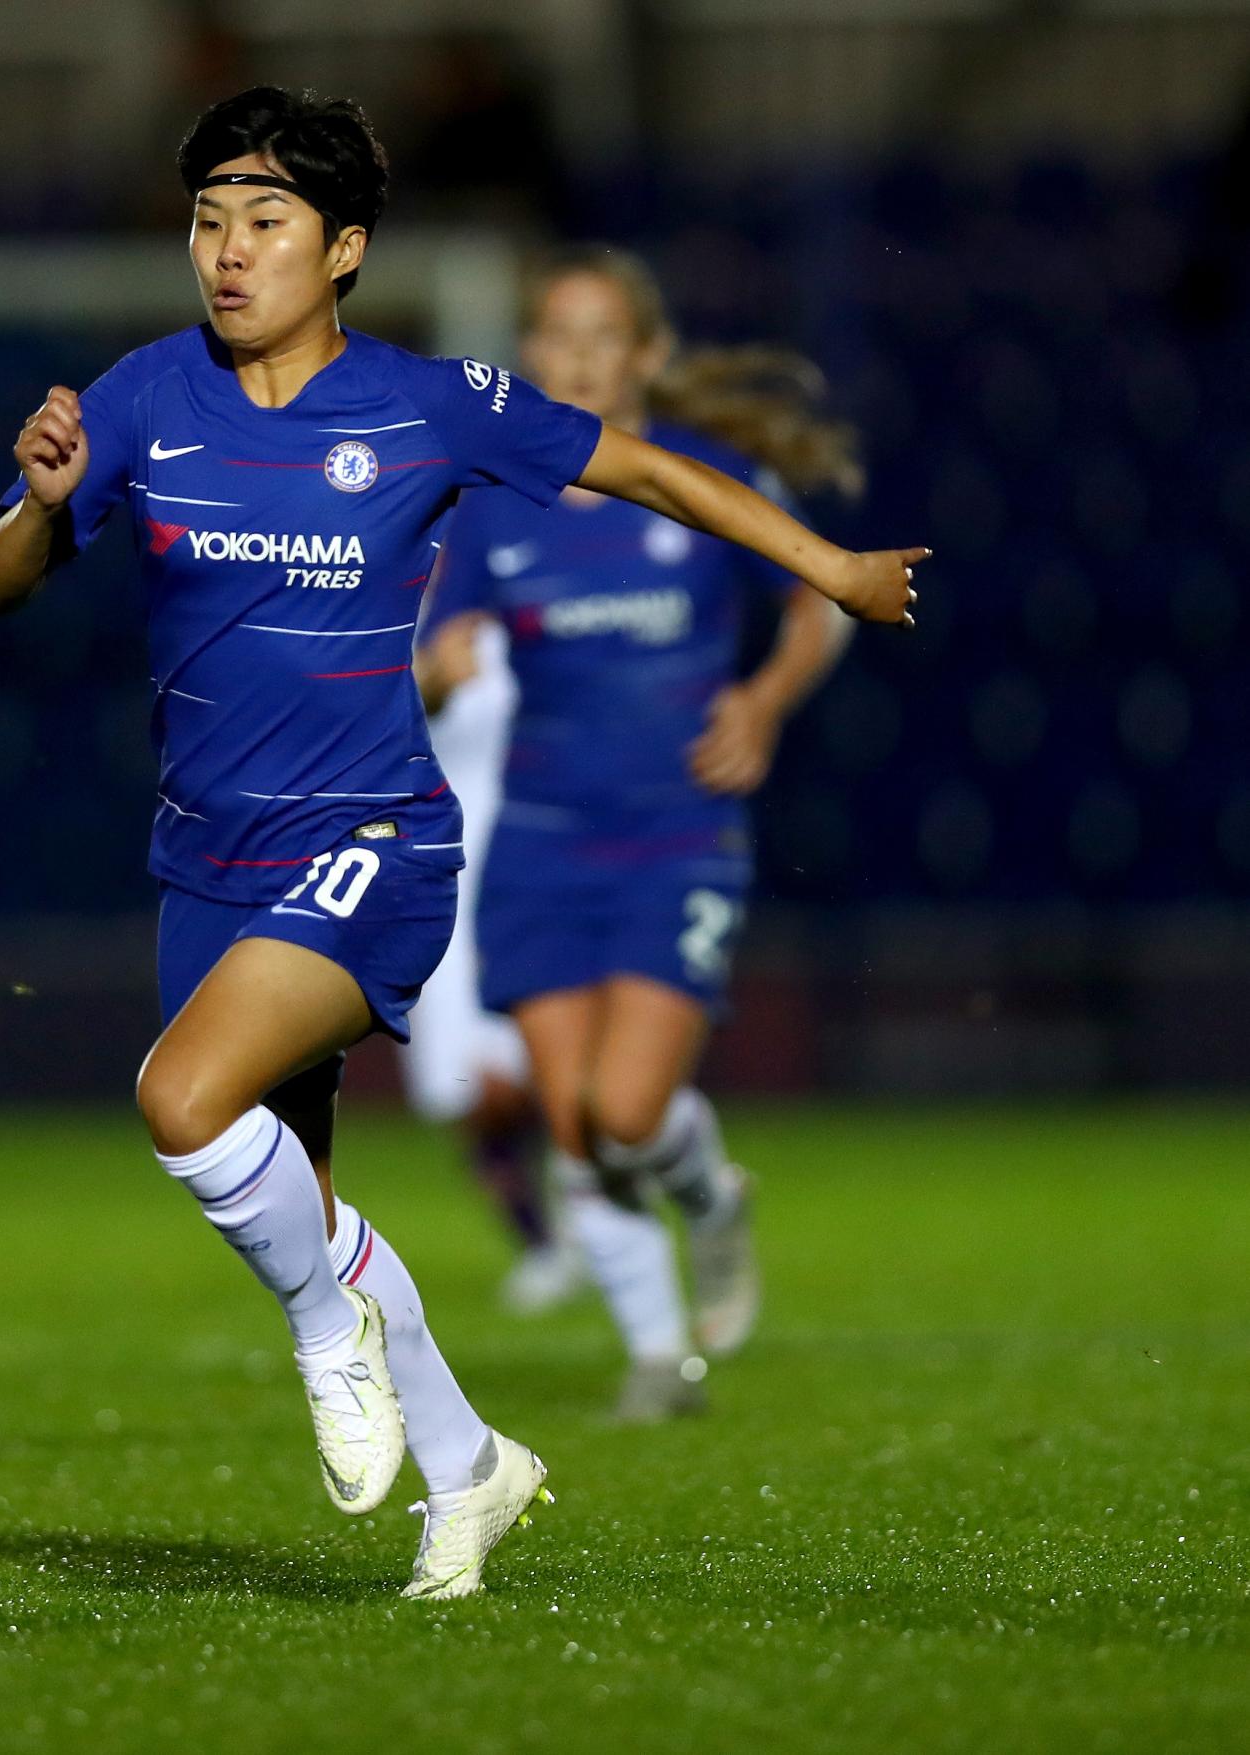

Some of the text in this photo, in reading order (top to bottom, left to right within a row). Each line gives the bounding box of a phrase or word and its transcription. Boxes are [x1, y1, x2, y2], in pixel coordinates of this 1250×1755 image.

[188, 530, 365, 565] YOKOHAMA
[285, 568, 363, 589] TYRES
[283, 847, 381, 919] 10
